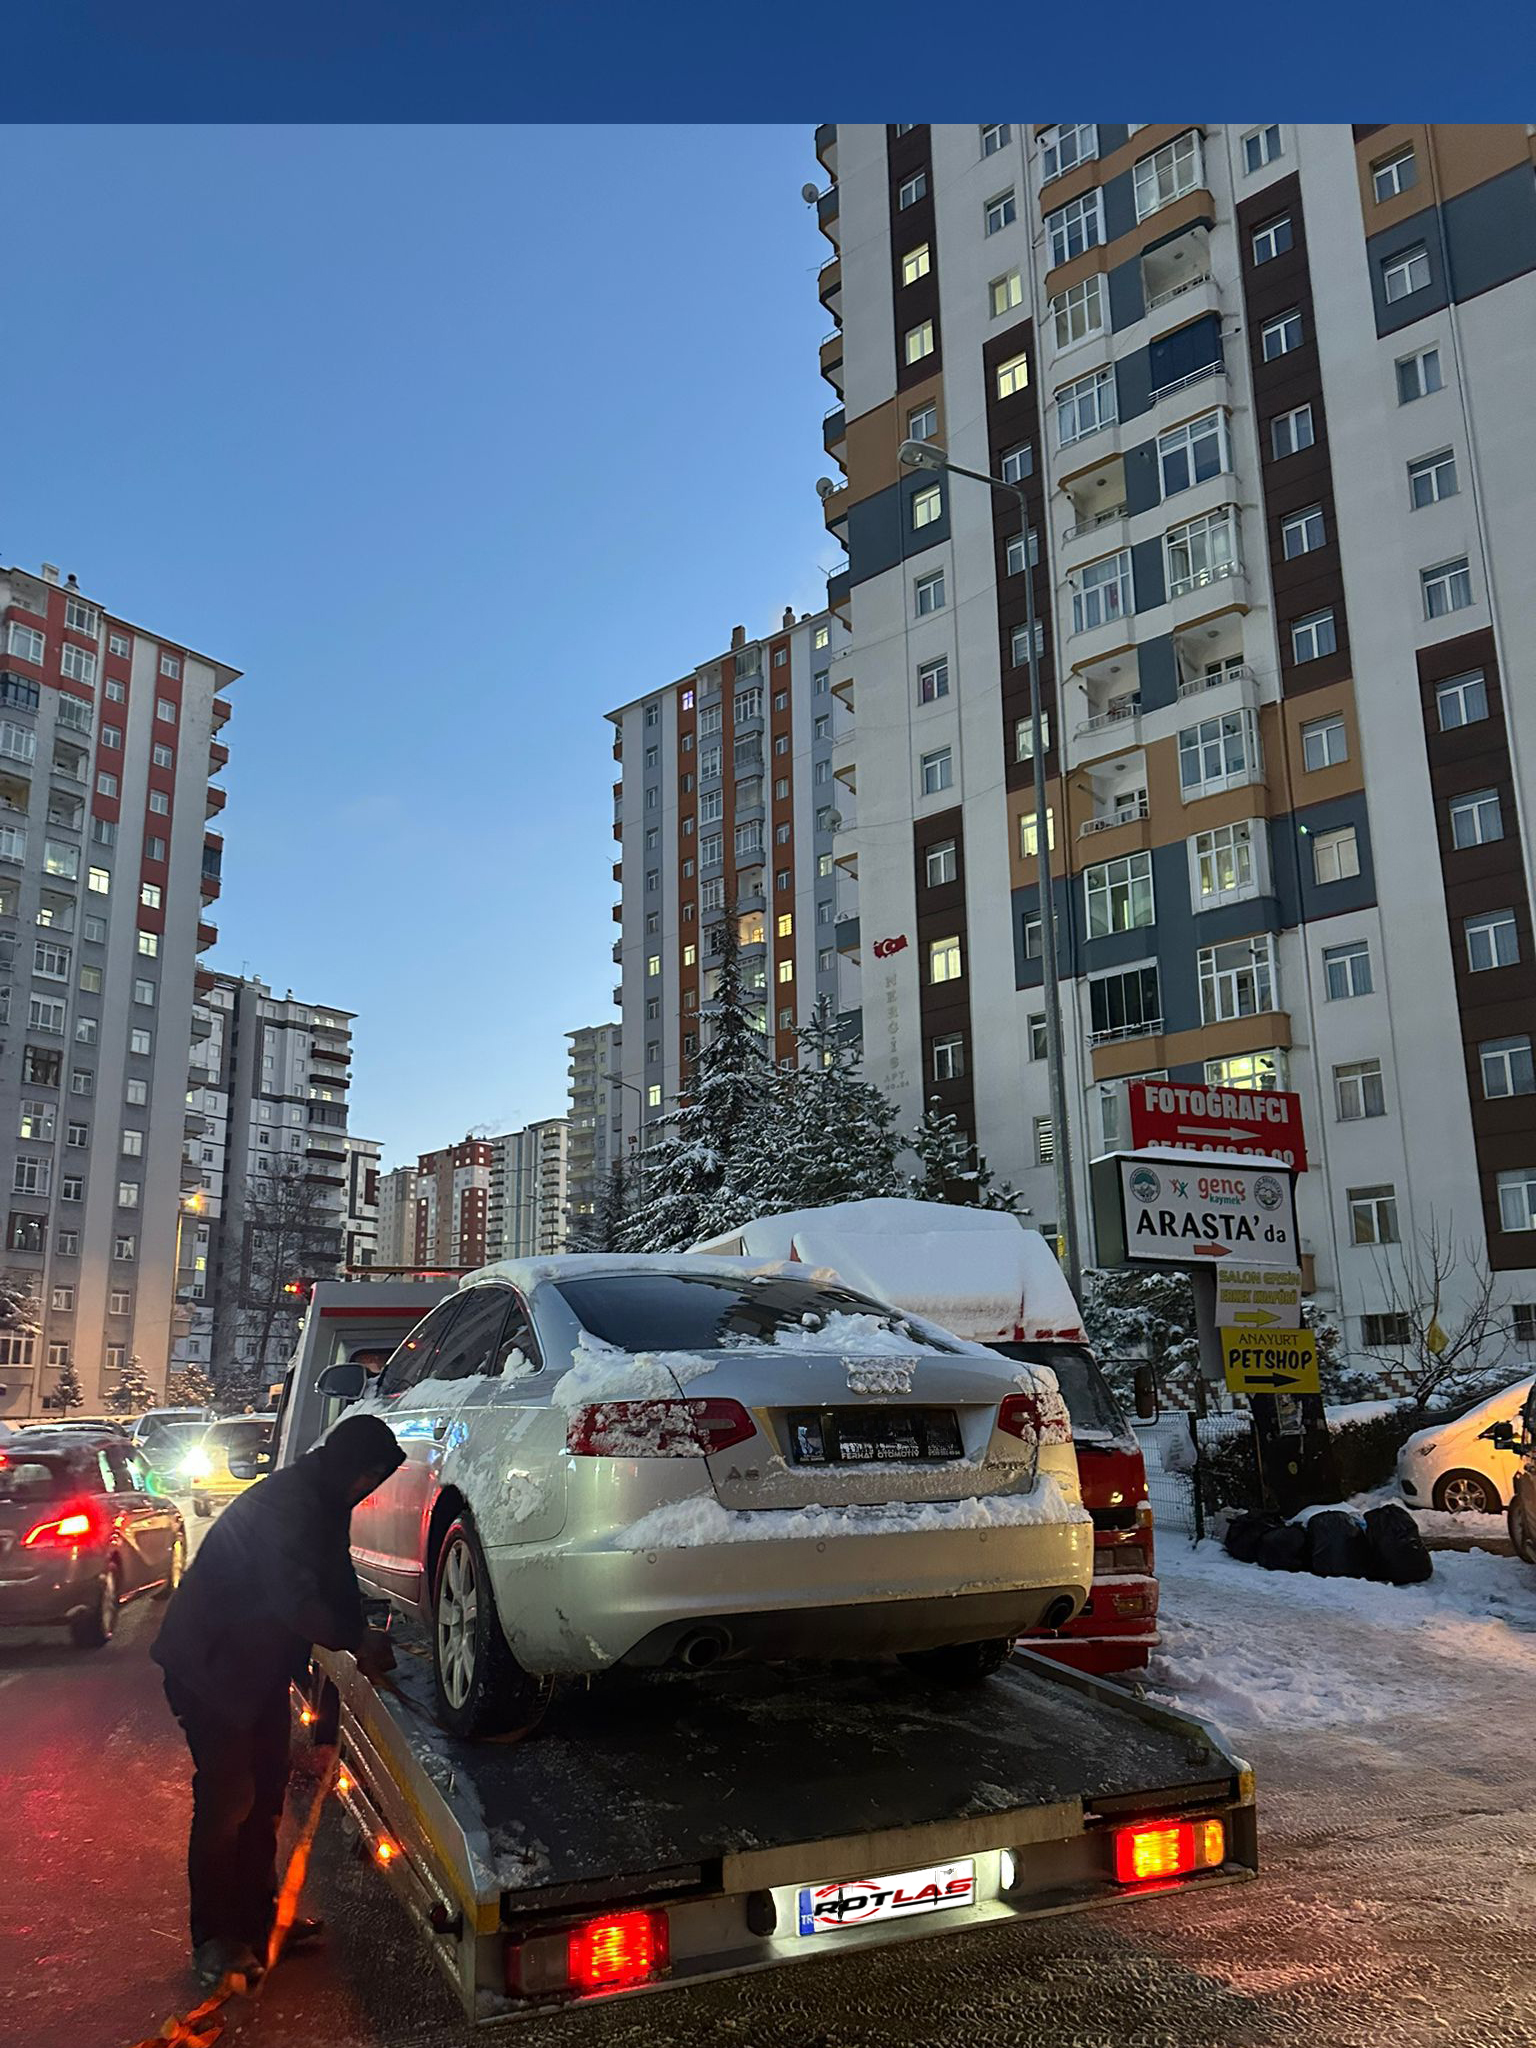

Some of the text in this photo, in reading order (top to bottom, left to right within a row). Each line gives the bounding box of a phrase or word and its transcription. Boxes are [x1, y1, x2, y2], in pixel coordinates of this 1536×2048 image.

[1198, 1177, 1246, 1201] genç
[1209, 1195, 1241, 1206] kaymek
[1218, 1269, 1261, 1284] SALON
[1238, 1333, 1299, 1346] ANAYURT
[1229, 1349, 1313, 1370] PETSHOP
[801, 1914, 814, 1925] TR
